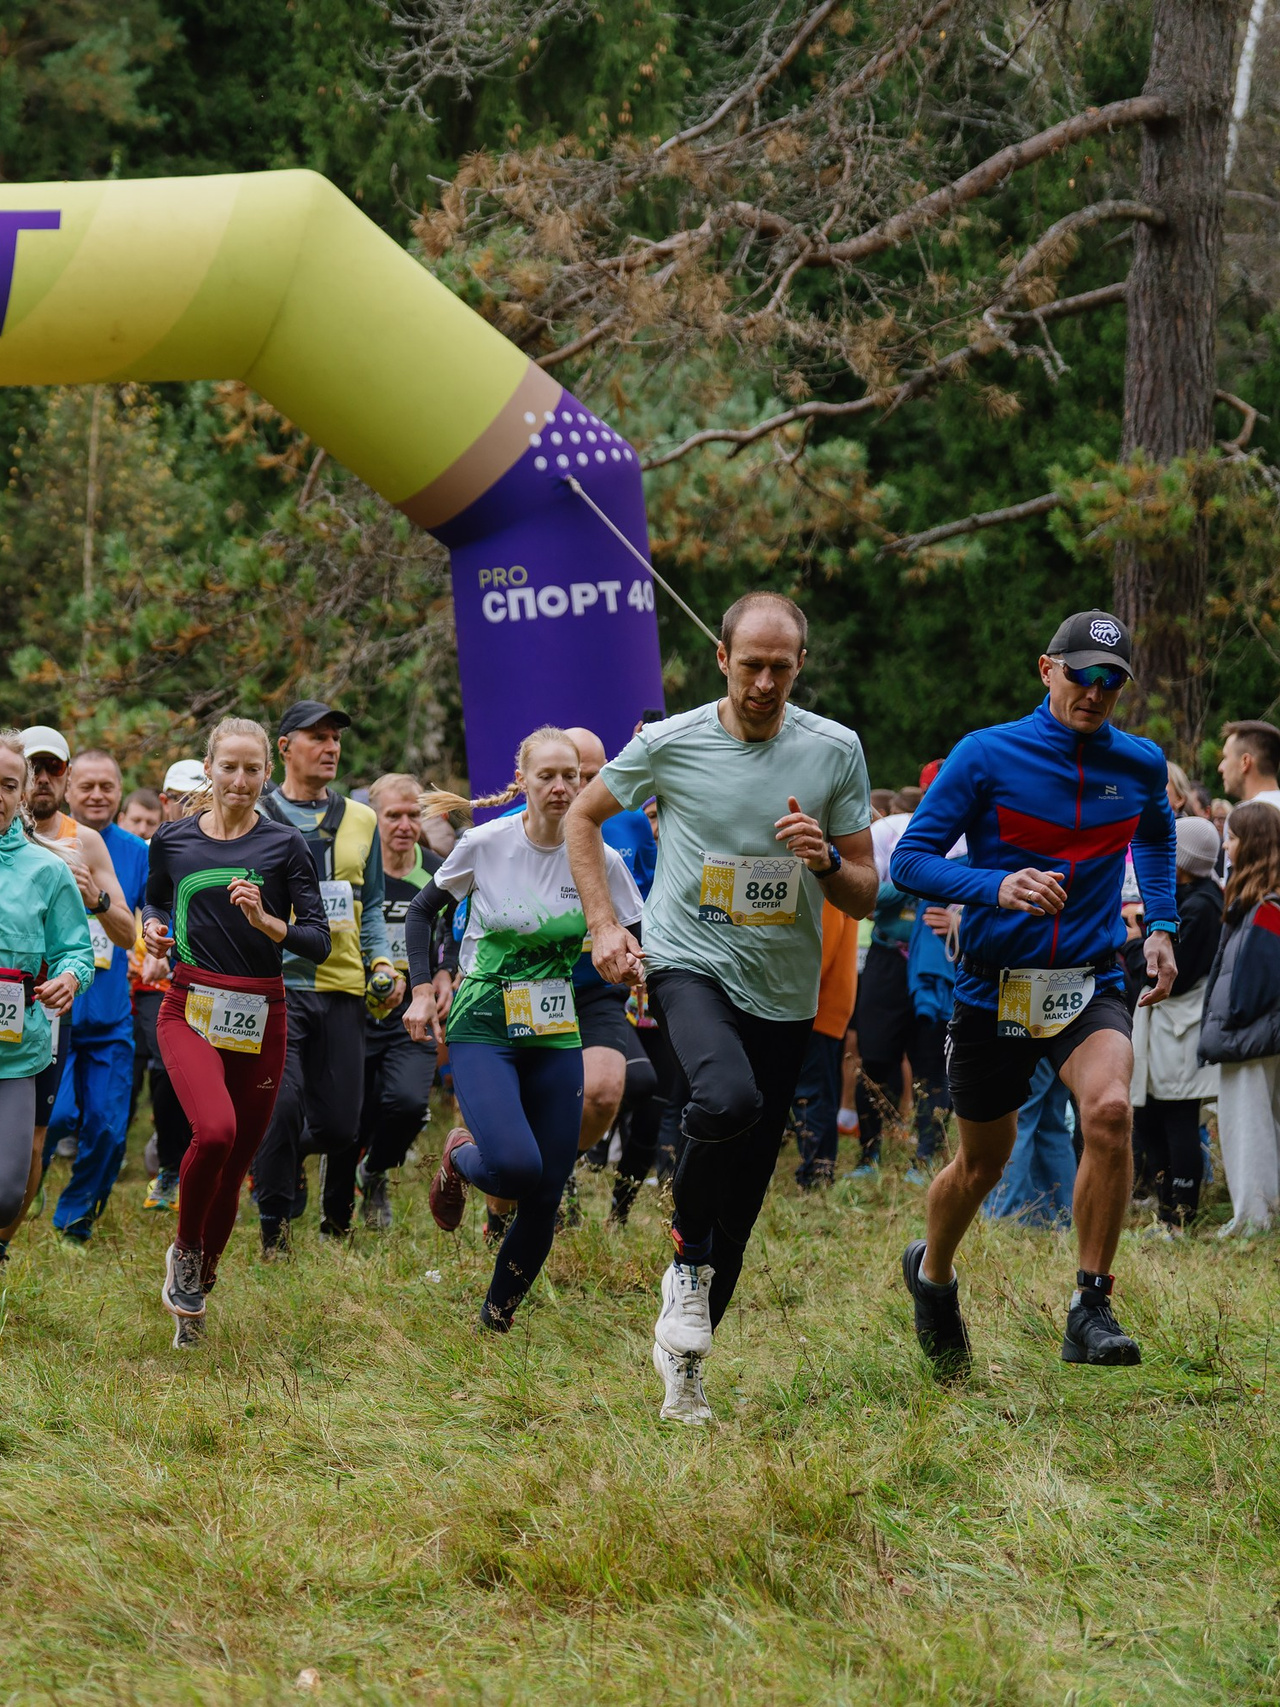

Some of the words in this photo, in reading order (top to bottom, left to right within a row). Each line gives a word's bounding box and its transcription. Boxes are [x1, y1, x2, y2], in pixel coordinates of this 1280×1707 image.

[478, 565, 528, 589] PRO
[482, 580, 622, 623] СПОРТ
[627, 580, 655, 612] 40
[745, 881, 788, 900] 868
[751, 900, 781, 909] СЕРГЕЙ
[541, 995, 566, 1012] 677
[1042, 991, 1083, 1012] 648
[224, 1010, 257, 1029] 126
[213, 1024, 260, 1037] АЛЕКСАНДРА
